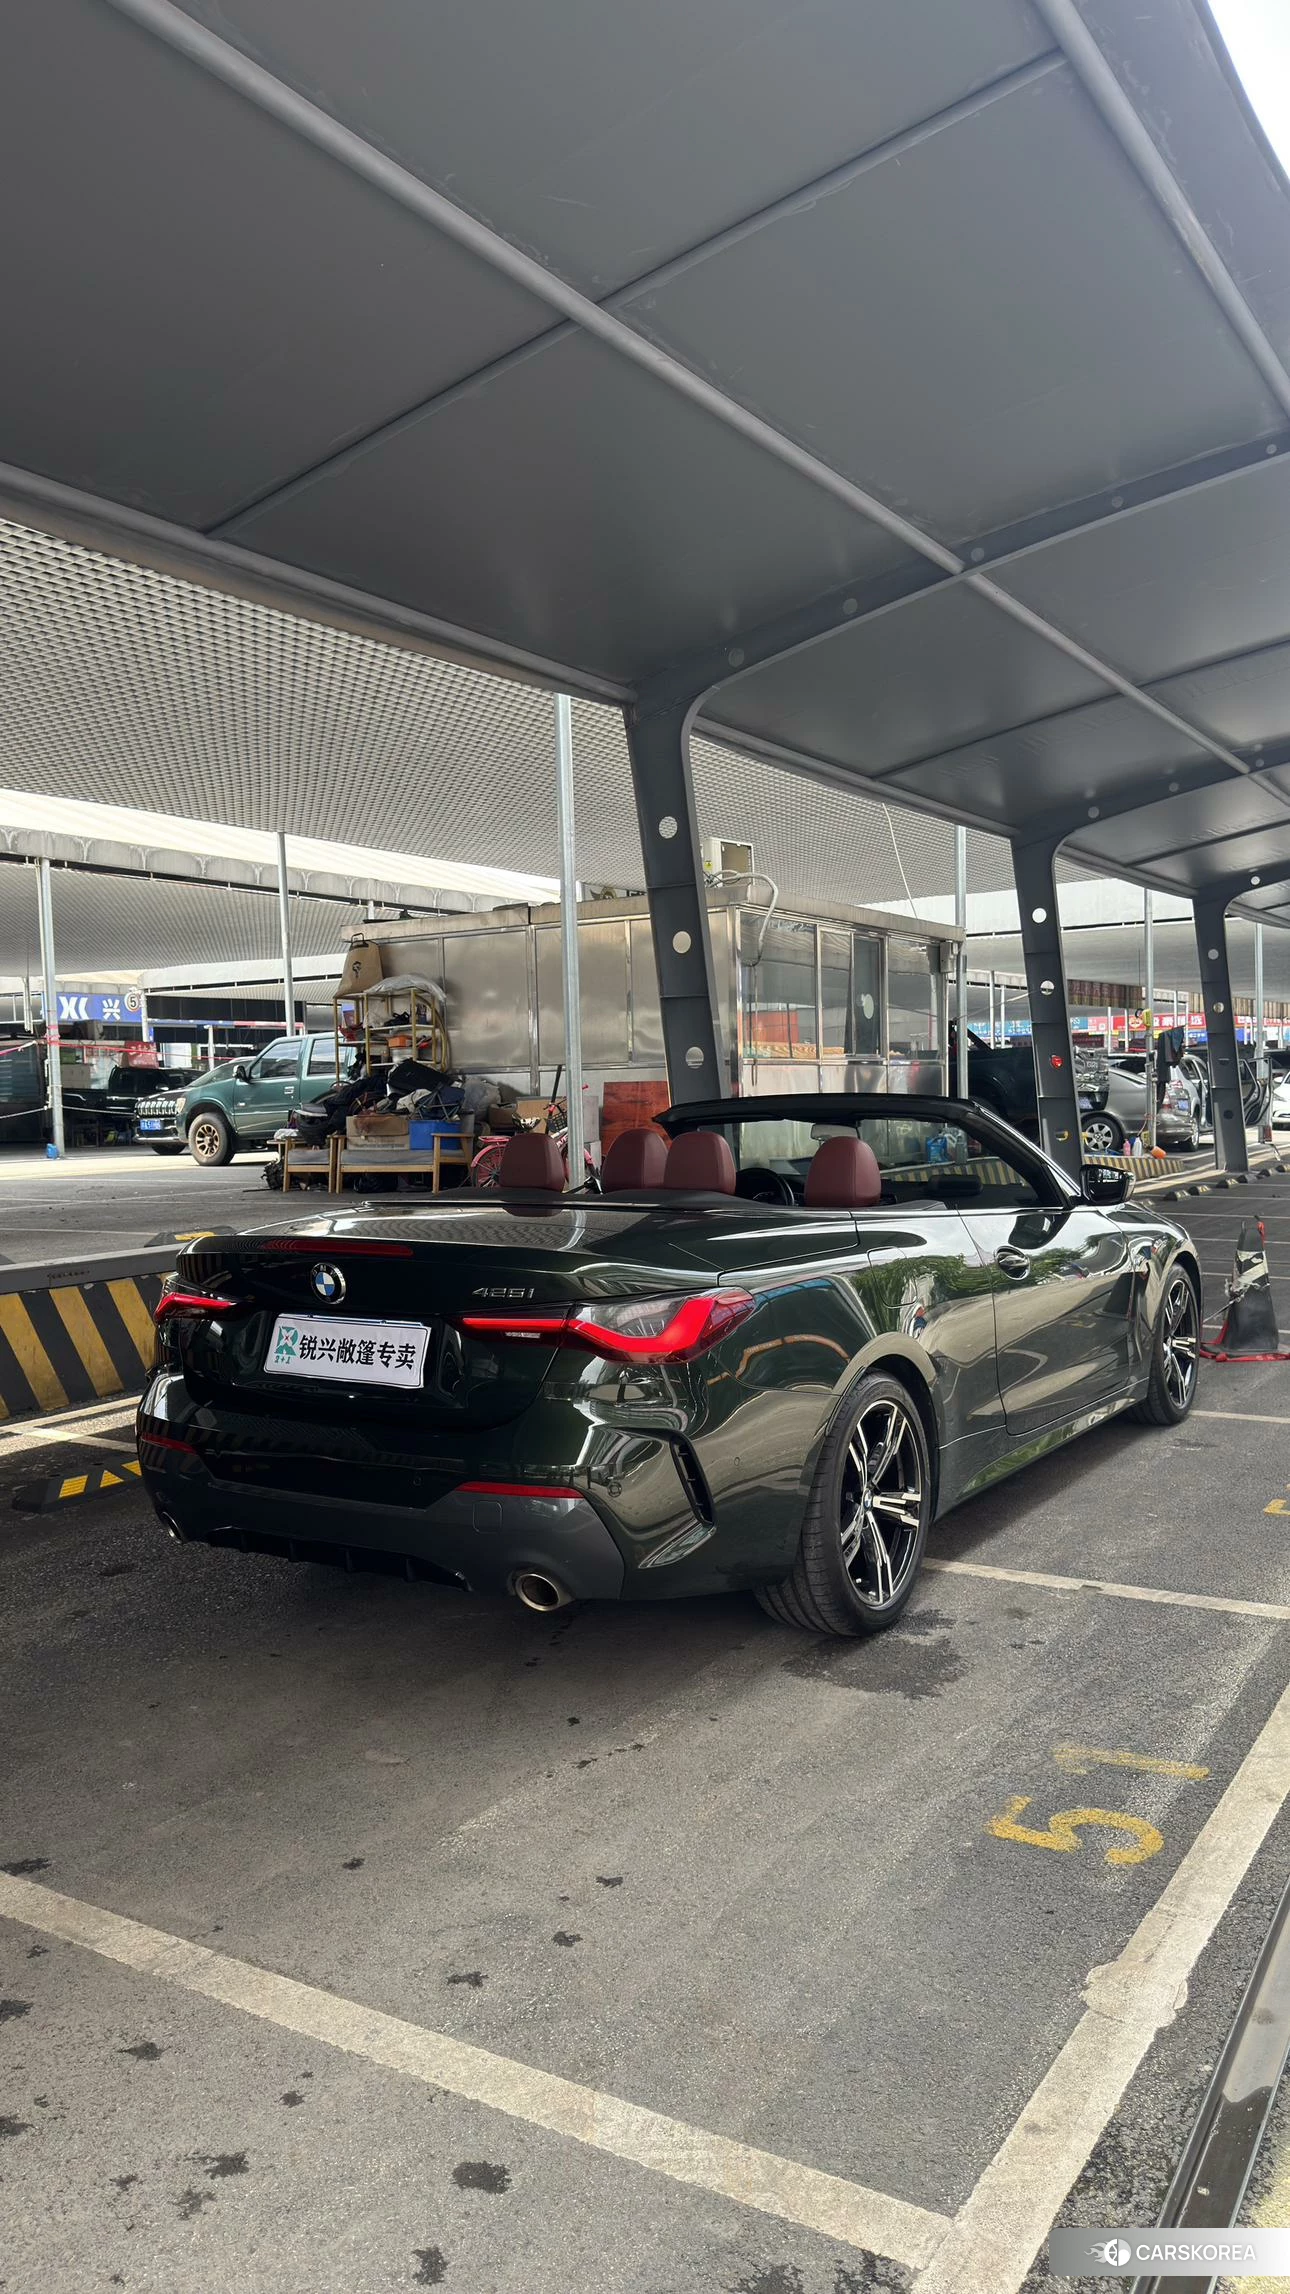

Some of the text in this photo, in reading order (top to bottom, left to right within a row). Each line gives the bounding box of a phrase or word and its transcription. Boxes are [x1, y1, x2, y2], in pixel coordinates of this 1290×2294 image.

[299, 1334, 416, 1370] 锐兴敞篷专卖
